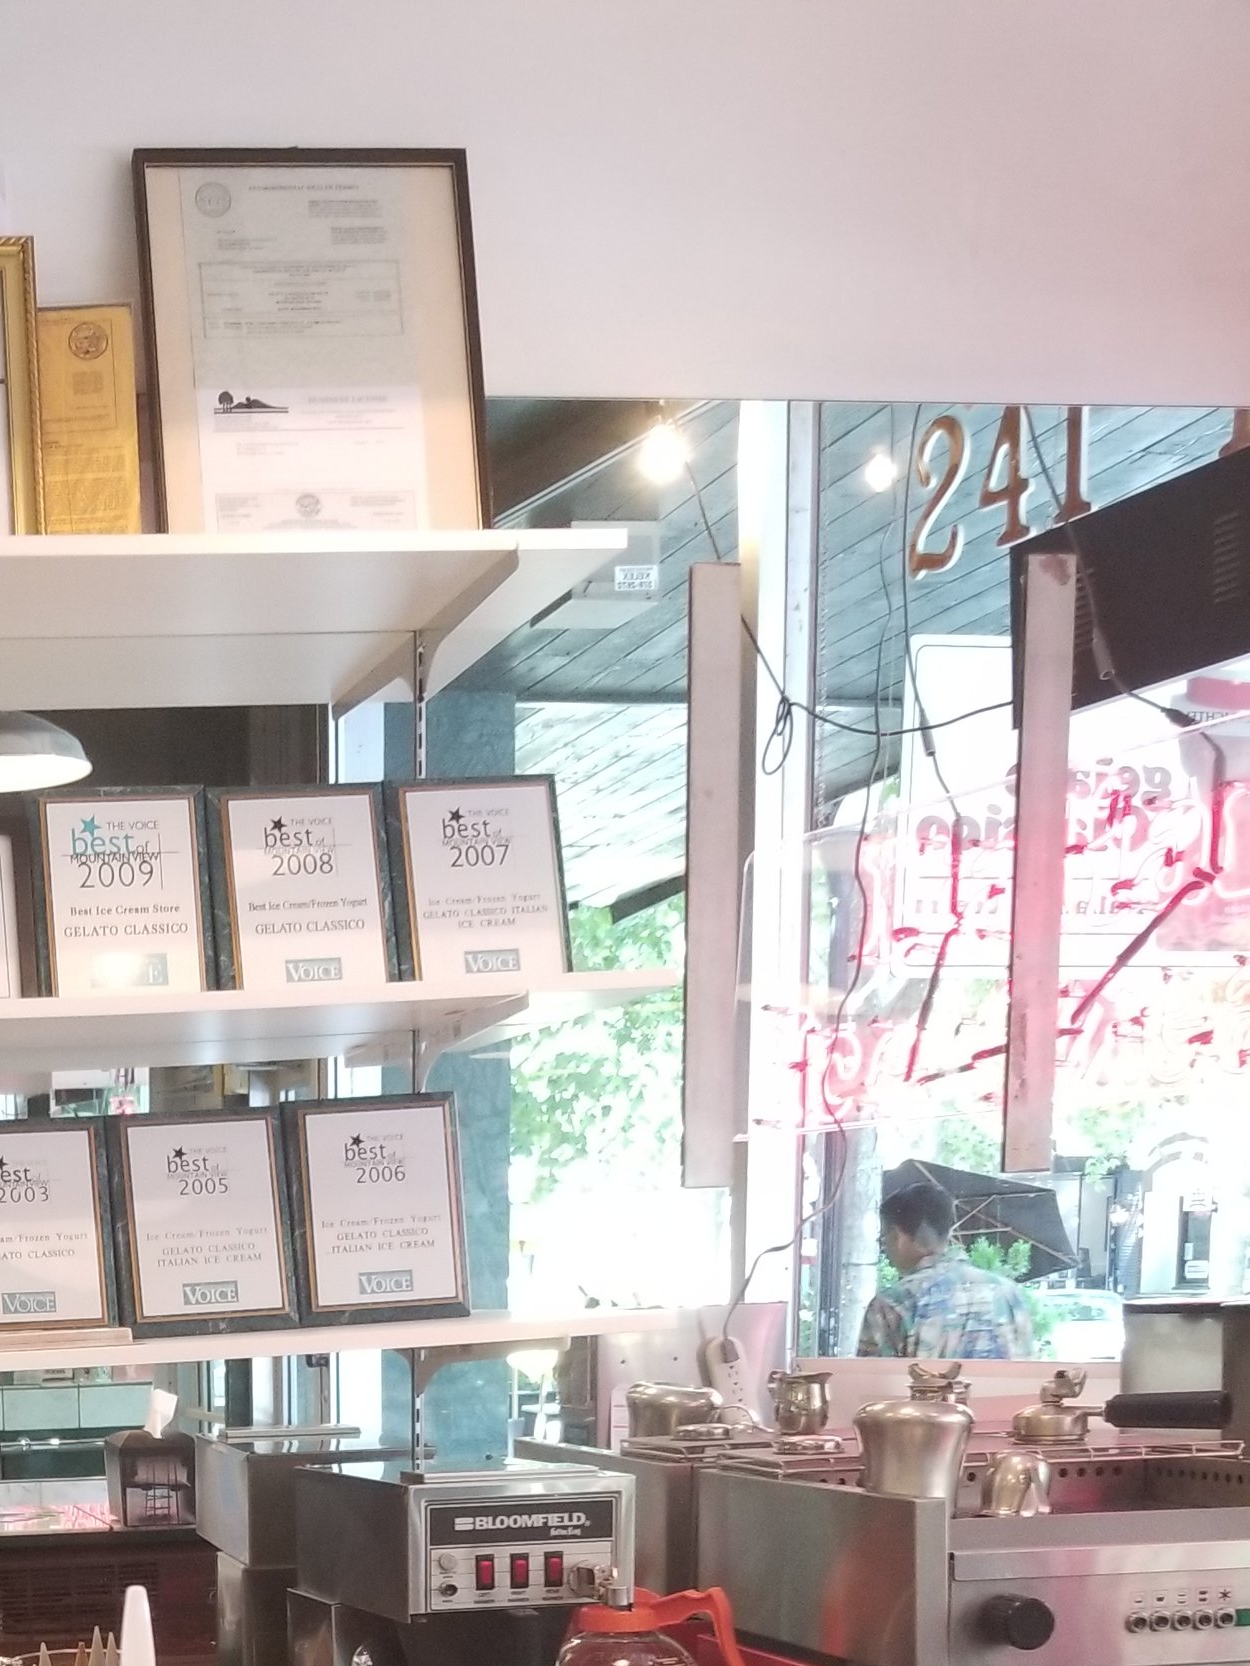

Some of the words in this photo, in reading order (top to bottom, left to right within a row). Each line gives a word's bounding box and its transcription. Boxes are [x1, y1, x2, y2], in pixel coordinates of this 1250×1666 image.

[106, 821, 125, 831] THE
[128, 820, 159, 830] VOICE
[442, 818, 491, 839] best
[71, 828, 134, 855] best
[135, 841, 150, 855] of
[264, 826, 313, 848] best
[70, 853, 131, 865] MOUNTAIN
[132, 852, 160, 863] VIEW
[271, 852, 334, 876] 2008
[450, 844, 509, 868] 2007
[78, 860, 154, 888] 2009
[70, 906, 92, 916] Best
[96, 906, 112, 915] Ice
[115, 905, 149, 915] Cream
[153, 904, 180, 913] Store
[248, 902, 266, 912] Best
[269, 902, 280, 911] Ice
[340, 898, 368, 909] Yogurt
[423, 910, 459, 919] GELATO
[464, 907, 507, 917] CLASSICO
[511, 905, 548, 914] ITALIAN
[64, 925, 119, 938] GELATO
[124, 923, 188, 936] CLASSICO
[255, 922, 303, 935] GELATO
[306, 919, 365, 932] CLASSICO
[458, 920, 474, 929] ICE
[480, 917, 516, 927] CREAM
[287, 961, 340, 981] VOICE
[466, 953, 518, 972] VOICE
[344, 1143, 386, 1161] best
[167, 1155, 209, 1174] best
[356, 1165, 406, 1184] 2006
[179, 1177, 228, 1196] 2005
[321, 1220, 334, 1229] Ice
[410, 1214, 442, 1224] Yogurt
[56, 1232, 88, 1241] Yogurt
[147, 1233, 159, 1241] Ice
[236, 1227, 268, 1237] Yogurt
[337, 1231, 377, 1242] GELATO
[382, 1228, 429, 1238] CLASSICO
[28, 1249, 75, 1259] CLASSICO
[163, 1246, 203, 1256] GELATO
[208, 1243, 255, 1253] CLASSICO
[331, 1244, 372, 1254] ITALIAN
[378, 1242, 394, 1251] ICE
[399, 1240, 435, 1249] CREAM
[158, 1257, 198, 1267] ITALIAN
[204, 1255, 220, 1265] ICE
[226, 1253, 261, 1263] CREAM
[360, 1276, 411, 1294] VOICE
[3, 1294, 56, 1313] VOICE
[183, 1286, 237, 1304] VOICE
[475, 1512, 587, 1530] BLOOMFIELD
